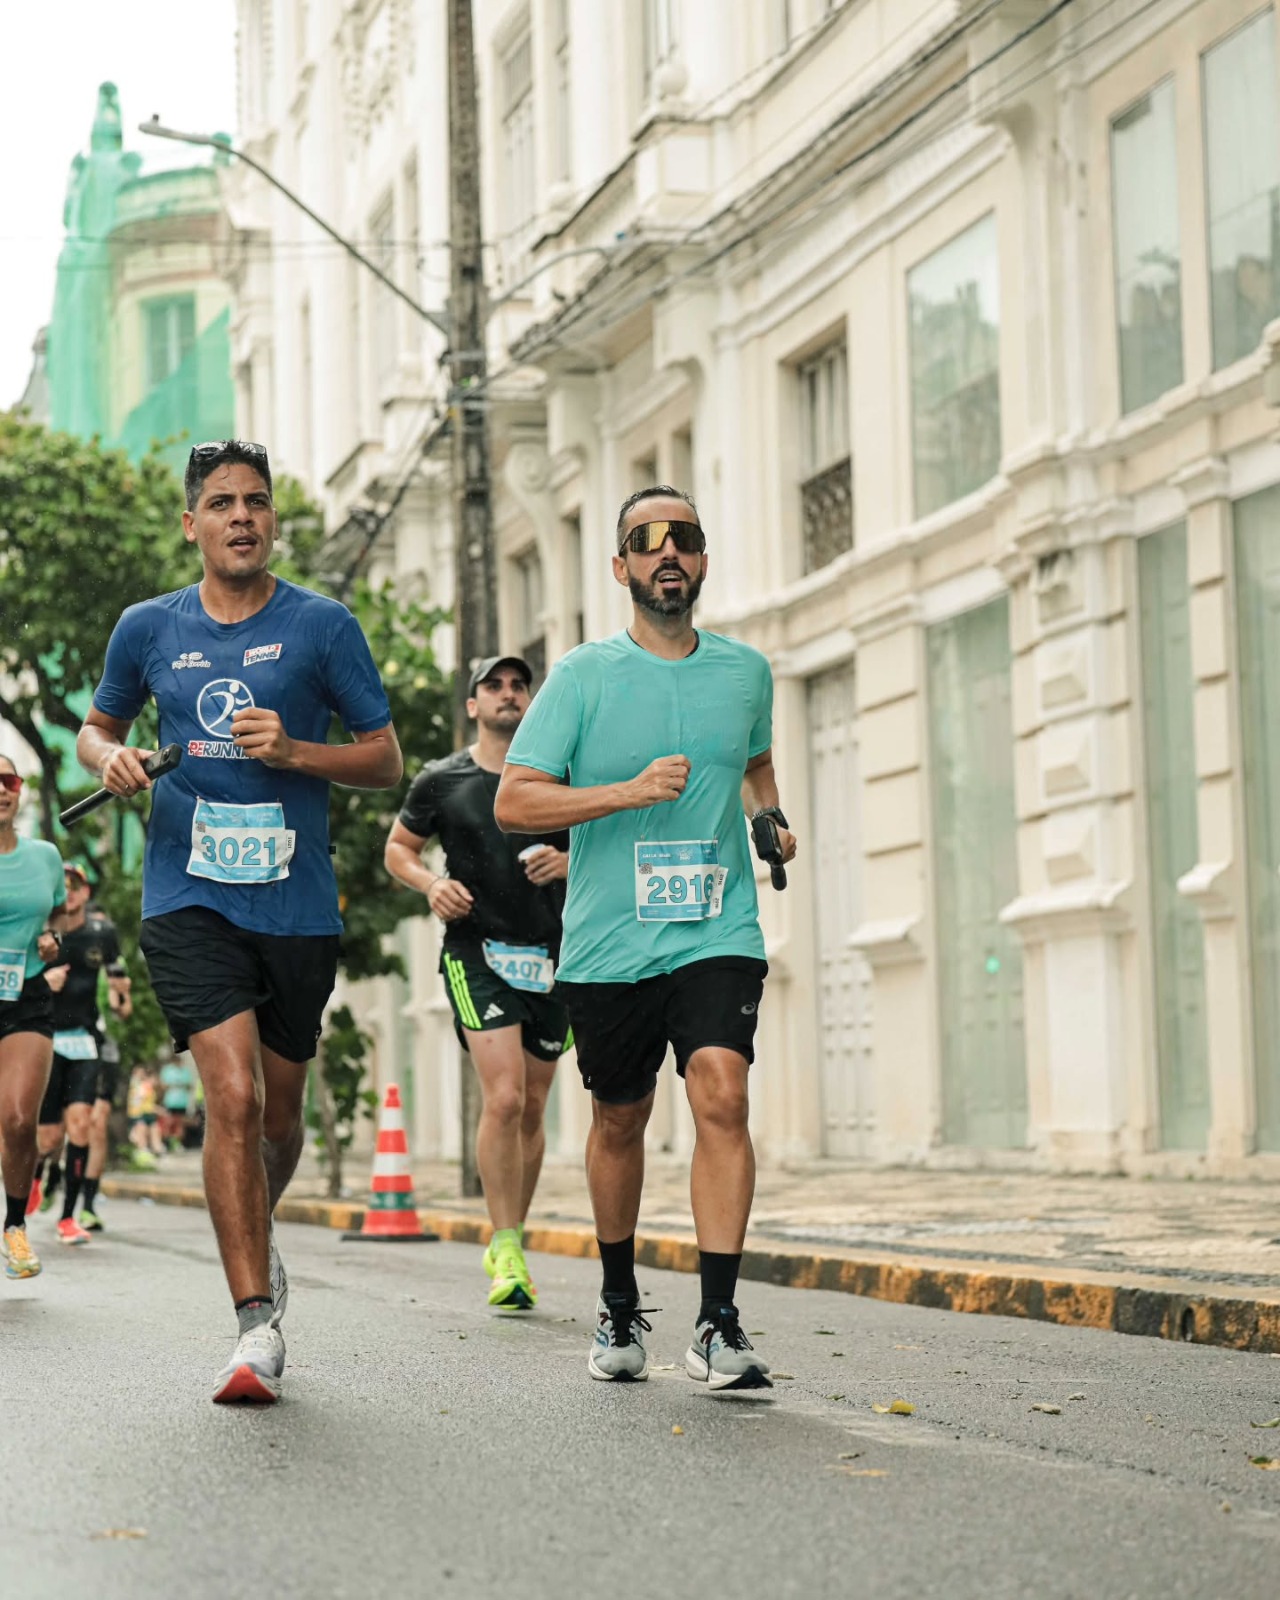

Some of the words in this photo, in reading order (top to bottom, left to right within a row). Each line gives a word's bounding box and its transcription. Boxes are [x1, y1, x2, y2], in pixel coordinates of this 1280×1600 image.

[245, 651, 278, 664] TENNIS
[188, 740, 256, 760] PERUNN
[201, 835, 276, 866] 3021
[647, 874, 714, 904] 2916
[491, 960, 543, 981] 2407
